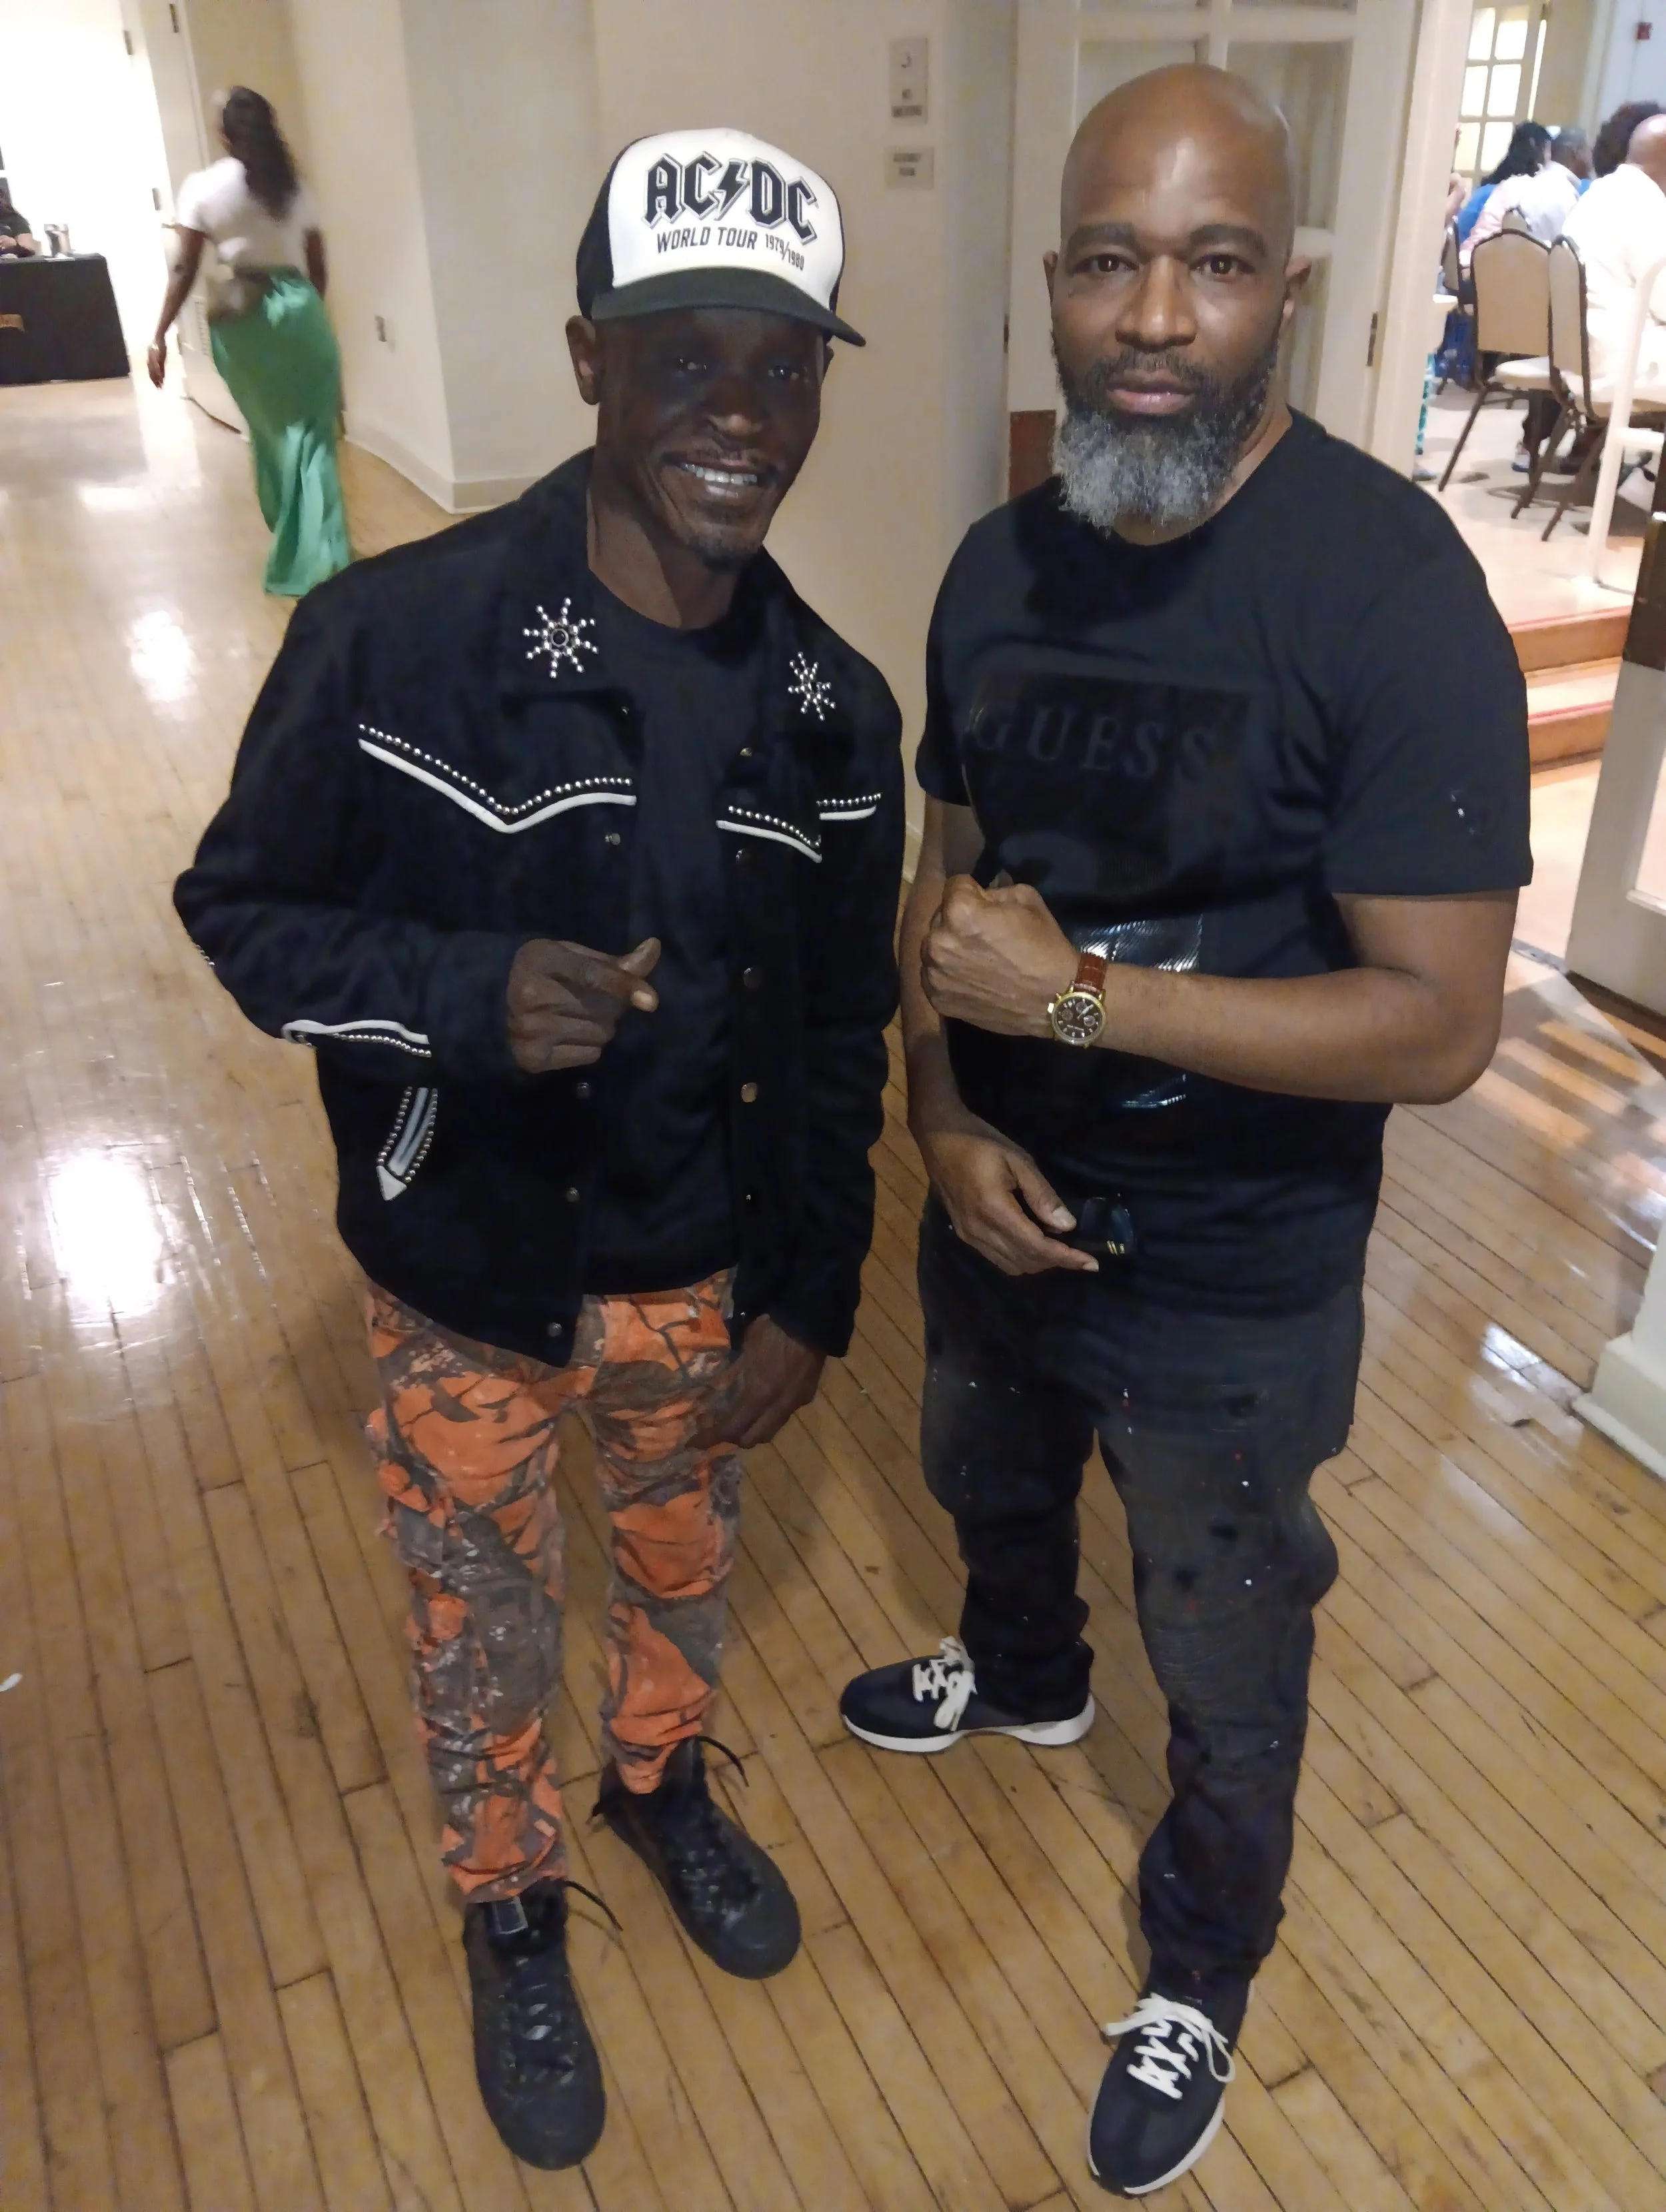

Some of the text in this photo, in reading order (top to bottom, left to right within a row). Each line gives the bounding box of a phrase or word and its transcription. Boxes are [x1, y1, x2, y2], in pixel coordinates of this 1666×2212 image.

[656, 226, 804, 271] WORLD TOUR 1979/1980
[968, 703, 1218, 782] GUESS
